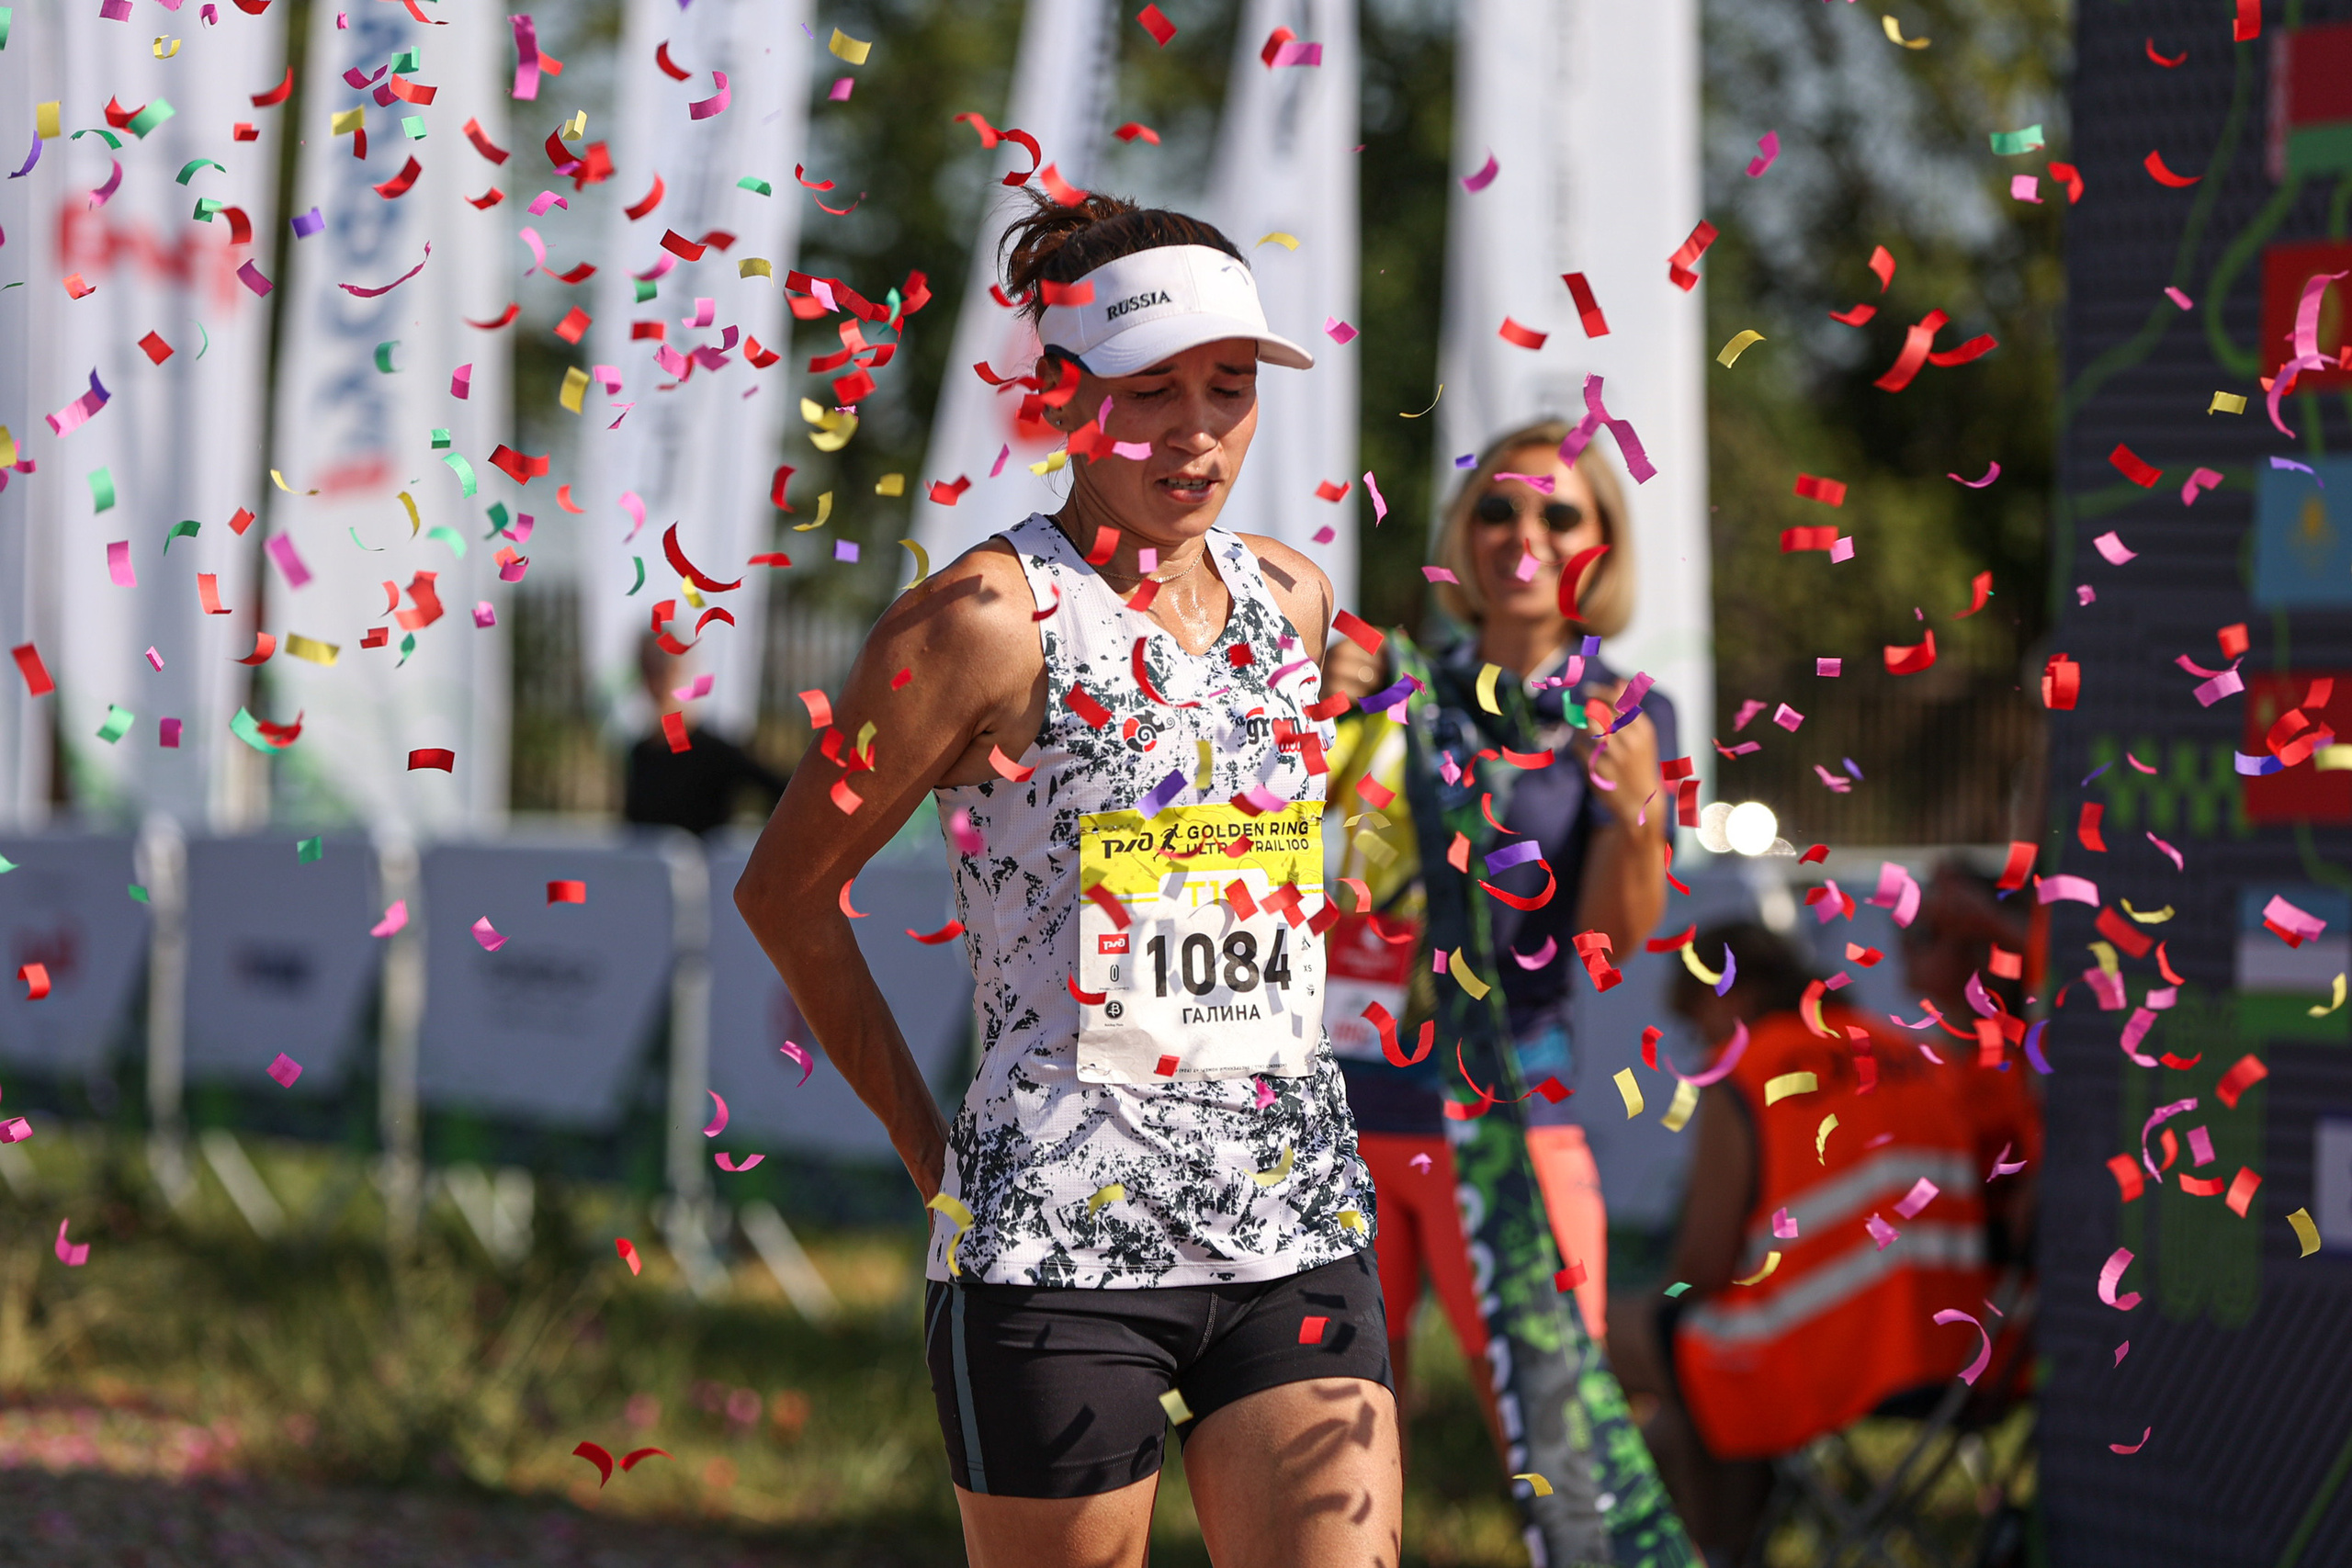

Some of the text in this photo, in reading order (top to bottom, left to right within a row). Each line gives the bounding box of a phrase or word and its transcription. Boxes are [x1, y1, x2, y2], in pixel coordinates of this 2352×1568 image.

[1105, 289, 1172, 322] RUSSIA
[1187, 820, 1309, 840] GOLDEN RING
[1182, 879, 1248, 908] T1
[1147, 929, 1292, 998] 1084
[1182, 1004, 1261, 1024] ГАЛИНА
